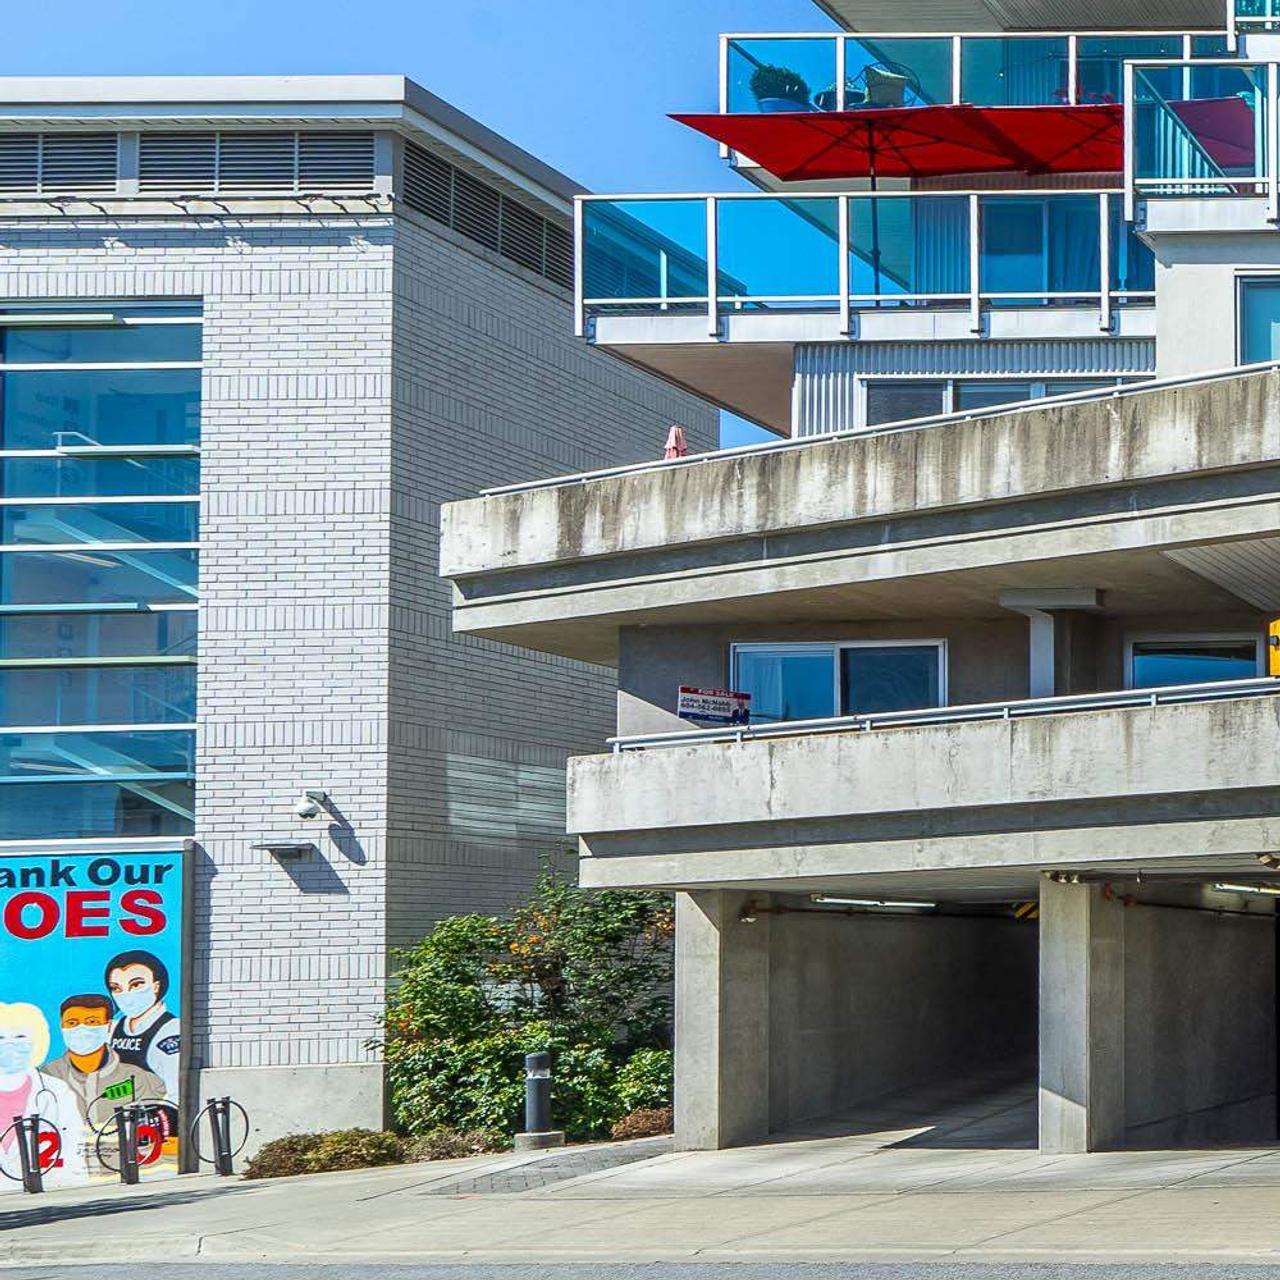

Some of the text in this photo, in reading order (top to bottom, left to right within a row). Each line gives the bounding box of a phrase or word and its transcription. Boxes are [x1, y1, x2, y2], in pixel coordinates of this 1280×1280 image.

[87, 857, 175, 887] Our
[3, 889, 167, 940] OES
[112, 1038, 142, 1051] POLICE
